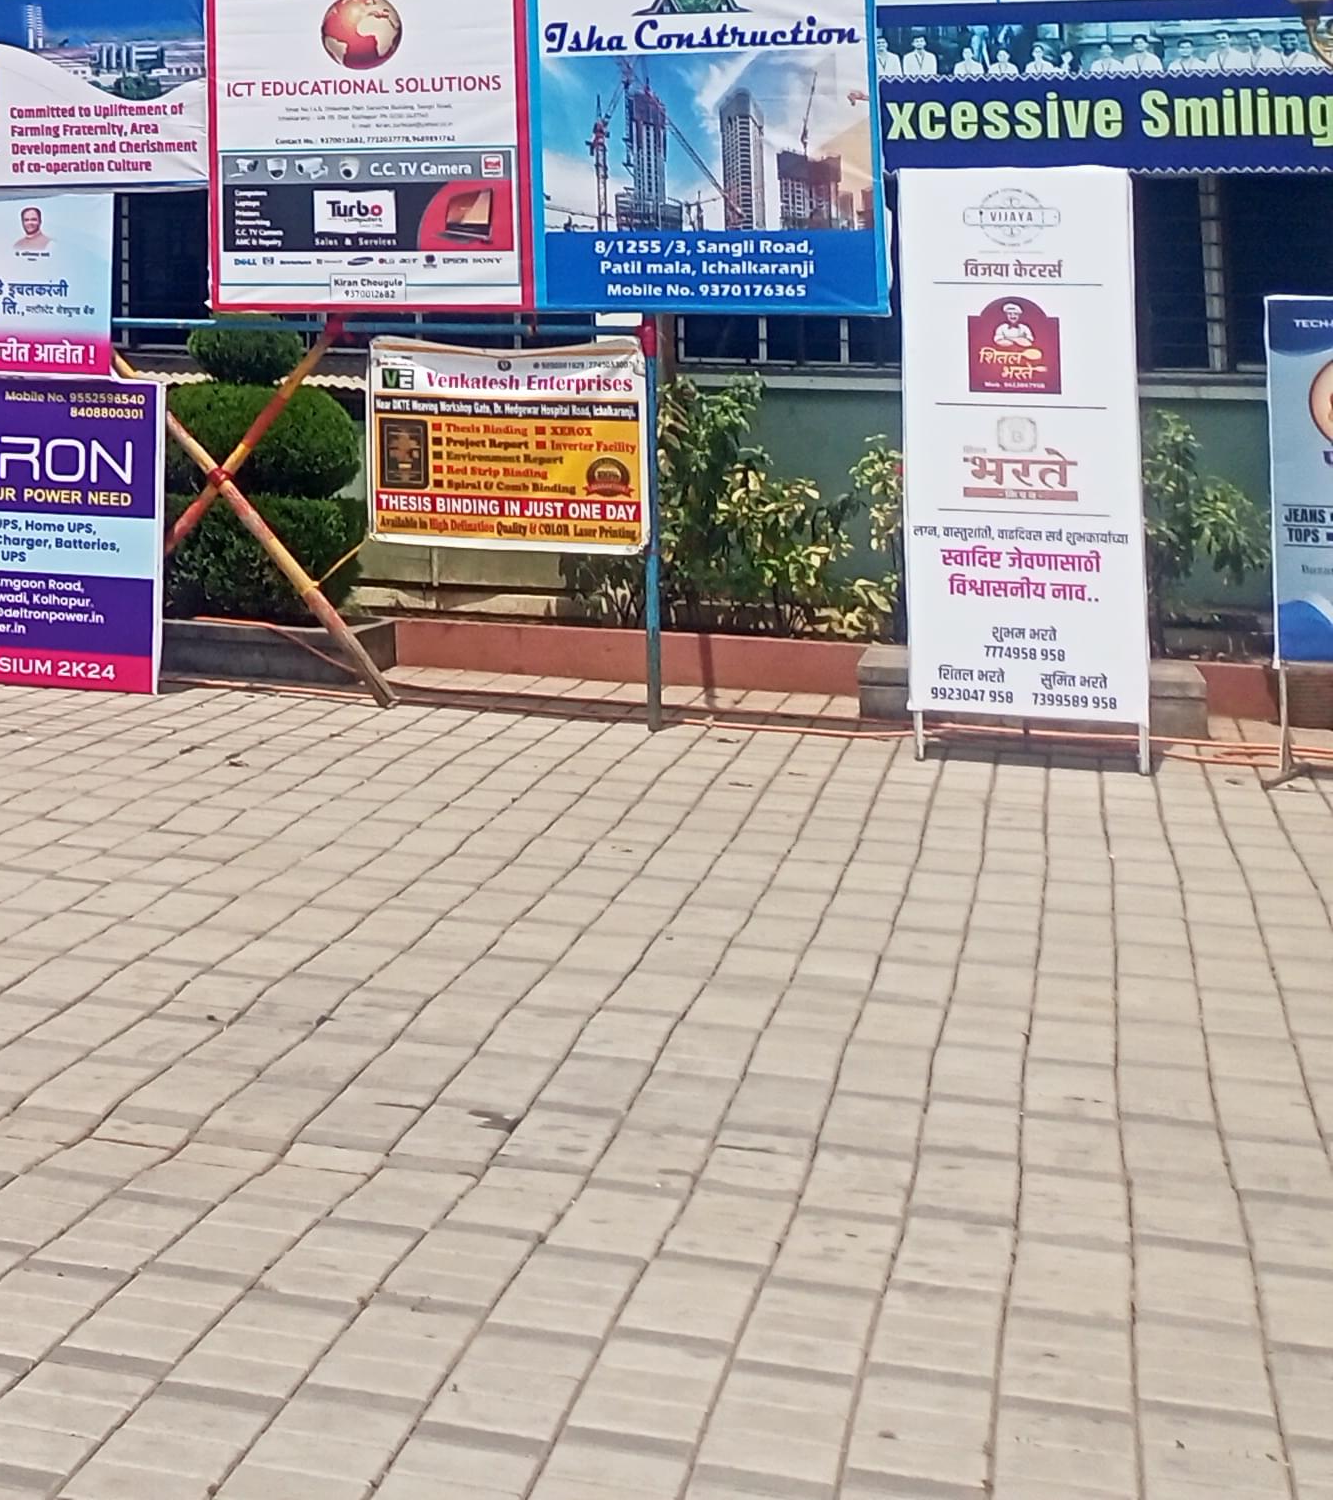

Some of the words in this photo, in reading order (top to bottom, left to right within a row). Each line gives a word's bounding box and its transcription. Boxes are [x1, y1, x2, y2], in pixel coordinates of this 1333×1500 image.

[544, 22, 627, 53] Isha
[635, 15, 860, 50] Construction
[227, 82, 255, 97] ICT
[262, 79, 389, 97] EDUCATIONAL
[395, 75, 502, 92] SOLUTIONS
[11, 125, 60, 138] Farming
[63, 122, 128, 137] Fraternity,
[131, 123, 158, 134] Area
[12, 142, 91, 156] Development
[94, 142, 116, 153] and
[119, 140, 197, 153] Cherishment
[327, 201, 383, 216] Turbo
[990, 211, 1033, 222] VIJAYA
[600, 260, 643, 274] Patil
[647, 261, 696, 276] mala,
[702, 260, 814, 278] Ichalkaranji
[965, 259, 1009, 277] विजया
[1013, 259, 1062, 278] केटरर्स
[8, 280, 68, 297] इचलकरंजी
[334, 279, 358, 287] Kiran
[361, 278, 402, 288] Chougule
[607, 283, 663, 297] Mobile
[667, 284, 695, 297] No.
[699, 283, 806, 297] 9370176365
[34, 339, 84, 364] आहोत
[426, 372, 520, 390] Venkatesh
[527, 374, 632, 395] Enterprises
[445, 423, 481, 433] Thesis
[483, 424, 528, 437] Binding
[24, 489, 82, 504] POWER
[89, 492, 132, 506] NEED
[379, 494, 431, 512] THESIS
[436, 497, 499, 515] BINDING
[505, 500, 520, 516] IN
[524, 501, 564, 517] JUST
[569, 503, 601, 519] ONE
[606, 505, 636, 520] DAY
[1284, 508, 1325, 523] JEANS
[1287, 528, 1319, 543] TOPS
[55, 538, 120, 552] Batteries,
[941, 545, 1002, 568] स्वादिष्ट
[1007, 547, 1101, 572] जेवणासाठी
[984, 645, 1037, 661] 7774958
[1041, 649, 1065, 662] 958
